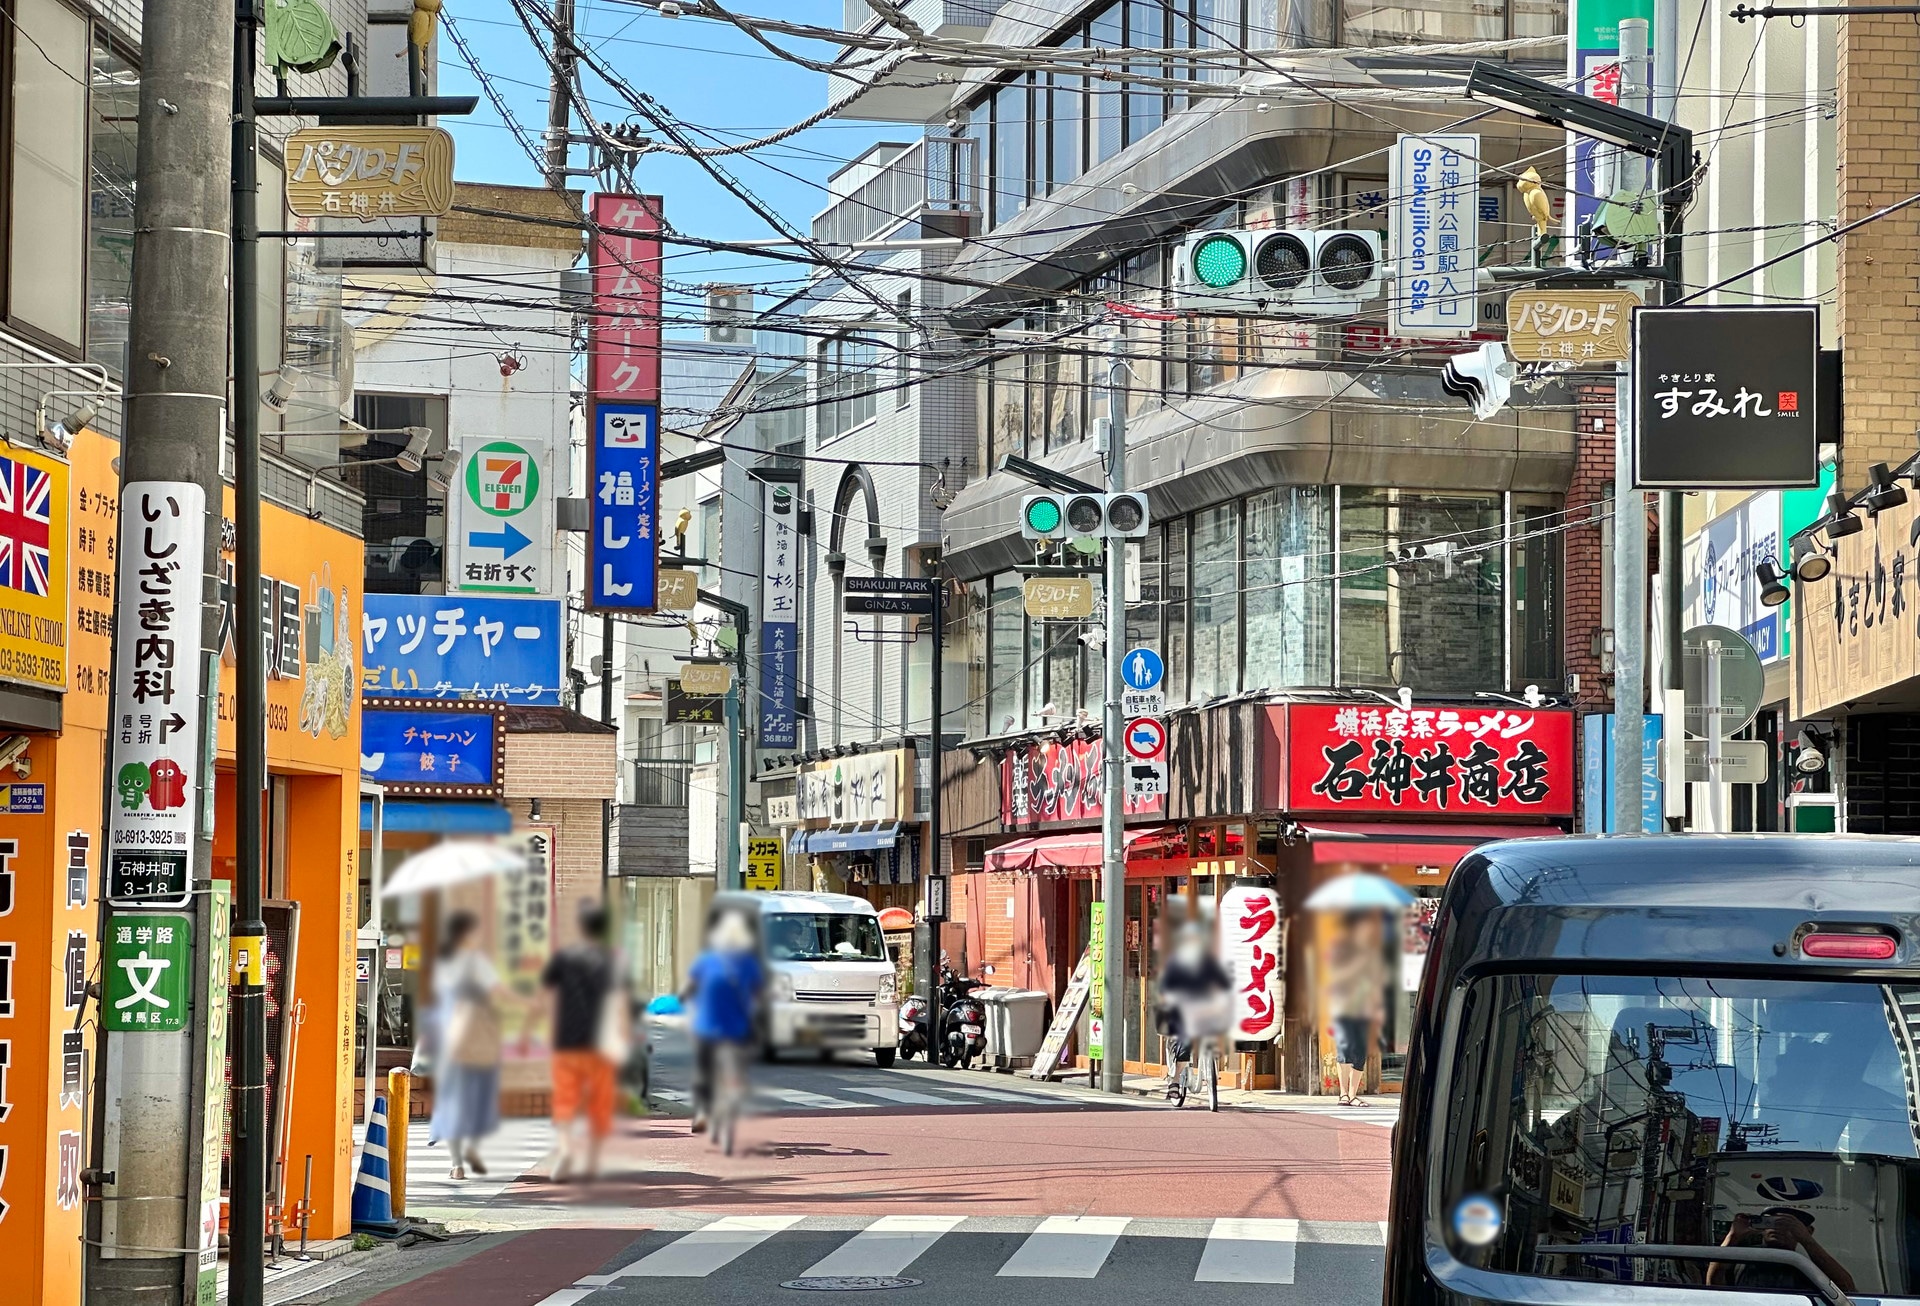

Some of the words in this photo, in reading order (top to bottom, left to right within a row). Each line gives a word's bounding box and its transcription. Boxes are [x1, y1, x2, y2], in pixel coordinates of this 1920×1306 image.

[292, 141, 424, 186] パークロード
[321, 191, 397, 212] 石神井
[1411, 149, 1432, 271] Shakujiikoen
[1438, 148, 1460, 315] 石神井公園駅入口
[610, 202, 644, 394] ゲームパーク
[1410, 279, 1430, 315] Sta.
[1512, 301, 1617, 336] パークロード
[1537, 341, 1596, 357] 石神井
[1658, 373, 1716, 383] やきとり家
[1653, 386, 1771, 418] すみれ
[1780, 393, 1796, 408] 笑
[79, 487, 118, 520] 金・プラチ
[637, 456, 651, 540] ラーメン・定食
[78, 527, 96, 554] 時計
[598, 471, 635, 596] 福しん
[465, 562, 537, 583] 右折すぐ
[767, 573, 794, 612] 杉玉
[849, 580, 897, 590] SHAKUJII
[900, 581, 928, 591] PARK
[1029, 585, 1080, 603] パークロード
[132, 493, 182, 705] いしざき内科
[864, 600, 898, 610] GINZA
[901, 601, 912, 611] St.
[1040, 606, 1070, 615] 石神井
[0, 607, 31, 640] NGLISH
[34, 616, 64, 648] SCHOOL
[362, 607, 541, 657] ャッチャー
[0, 648, 61, 682] 03-5393-7855
[773, 627, 785, 710] 大衆寿司居酒屋
[76, 664, 110, 696] その他、何で
[362, 664, 419, 691] だい
[434, 681, 543, 701] ゲームパーク
[1125, 695, 1161, 704] 自転車を除く
[676, 709, 714, 721] 三井堂
[1129, 704, 1158, 713] 15-18
[121, 714, 152, 729] 信号
[778, 723, 793, 732] 2F
[1328, 707, 1535, 739] 横浜家系ラーメン
[121, 730, 152, 744] 右折
[403, 727, 477, 747] チャーハン
[764, 734, 794, 743] 36席あり
[419, 752, 461, 772] 餃子
[1311, 738, 1550, 810] 石神井商店
[17, 796, 37, 804] システム
[114, 830, 173, 845] 03-6913-3925
[119, 861, 177, 877] 石神井町
[747, 863, 775, 877] 宝石
[124, 881, 169, 897] 3-18
[116, 926, 173, 944] 通学路
[1091, 908, 1104, 1018] ふれあい広場
[1239, 894, 1276, 1035] ラーメン
[114, 950, 171, 1009] 文
[56, 828, 90, 1211] 高値買取
[121, 1011, 161, 1023] 練馬区
[203, 893, 227, 1194] ふれあい広場
